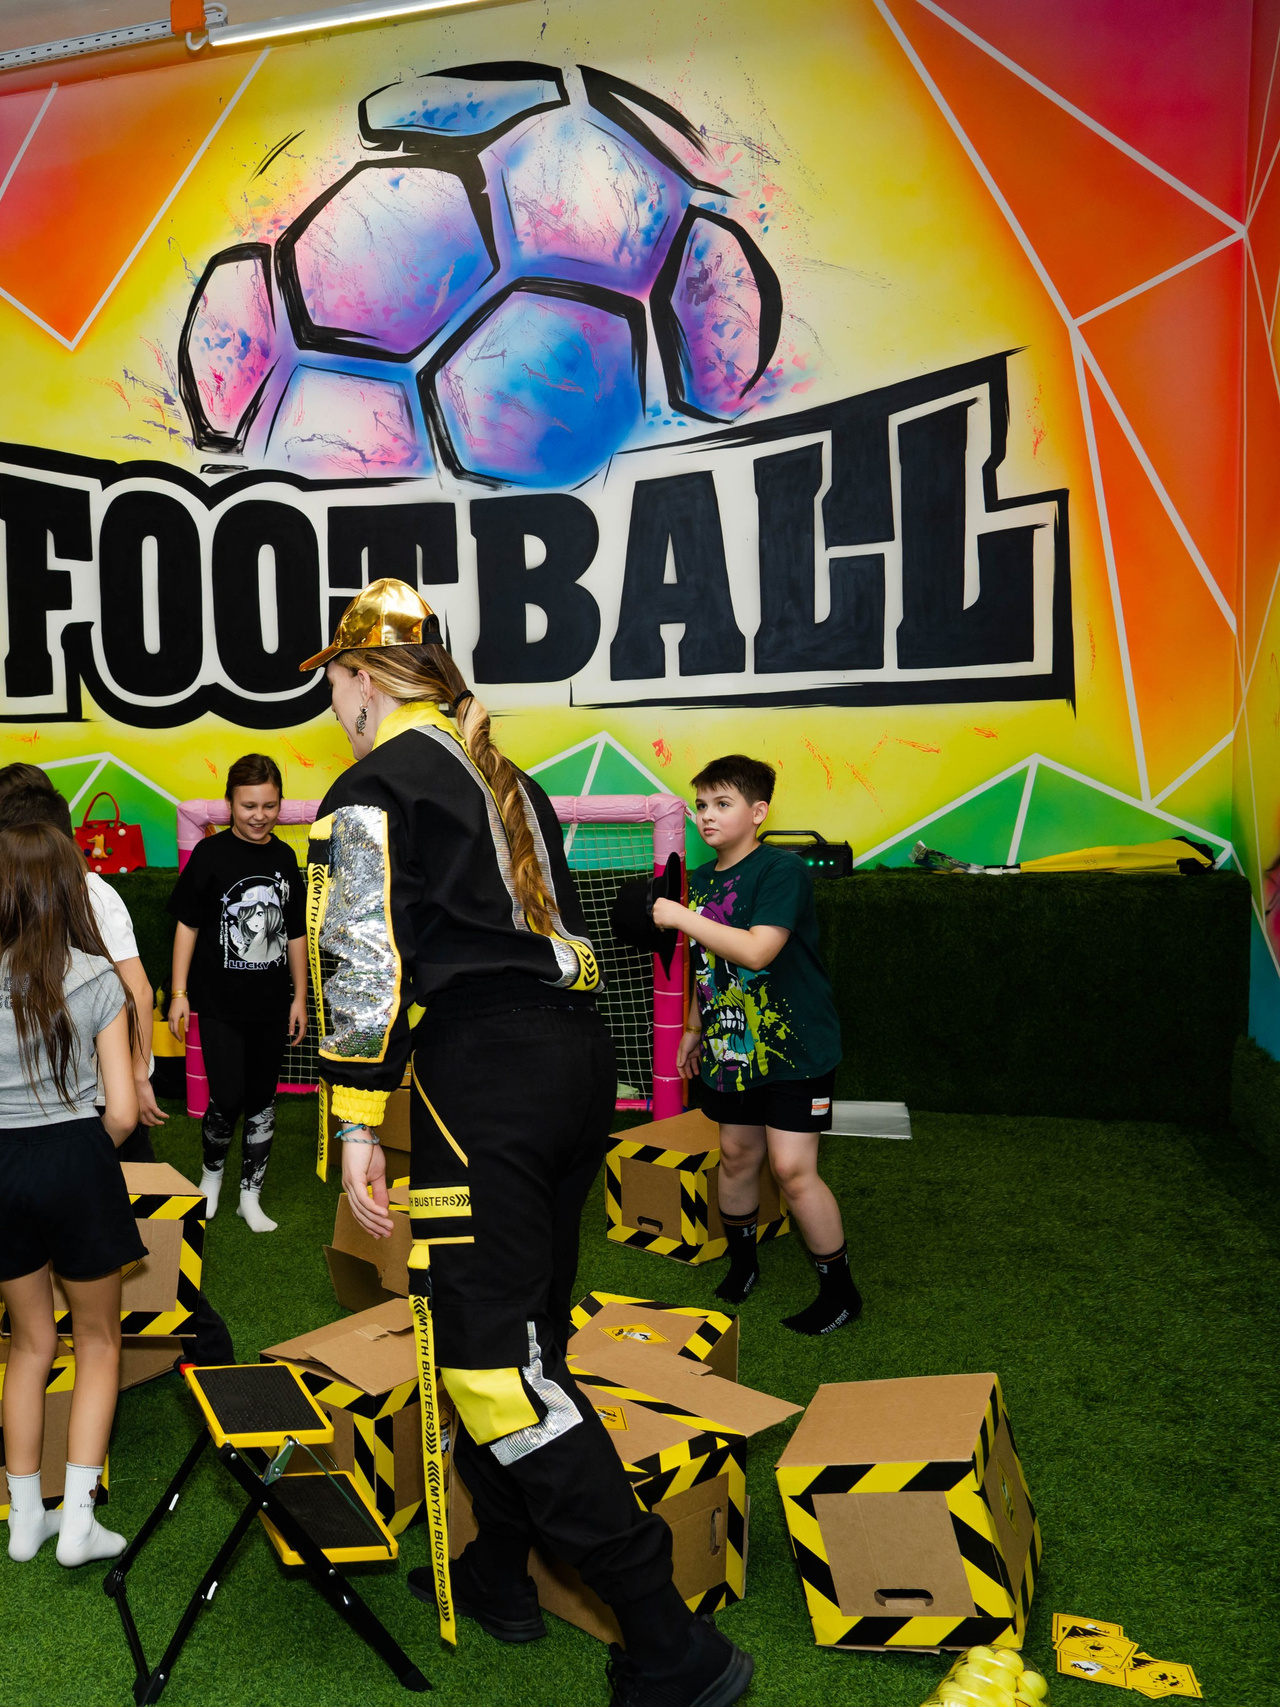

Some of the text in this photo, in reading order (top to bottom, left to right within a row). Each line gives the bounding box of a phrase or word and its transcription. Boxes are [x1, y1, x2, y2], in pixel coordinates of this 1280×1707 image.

[310, 883, 323, 923] MYTH
[229, 960, 270, 970] LUCKY
[414, 1195, 456, 1207] BUSTERS
[820, 1309, 850, 1335] TEAM SPORT
[419, 1315, 435, 1430] MYTH BUSTERS
[430, 1485, 446, 1599] MYTH BUSTERS
